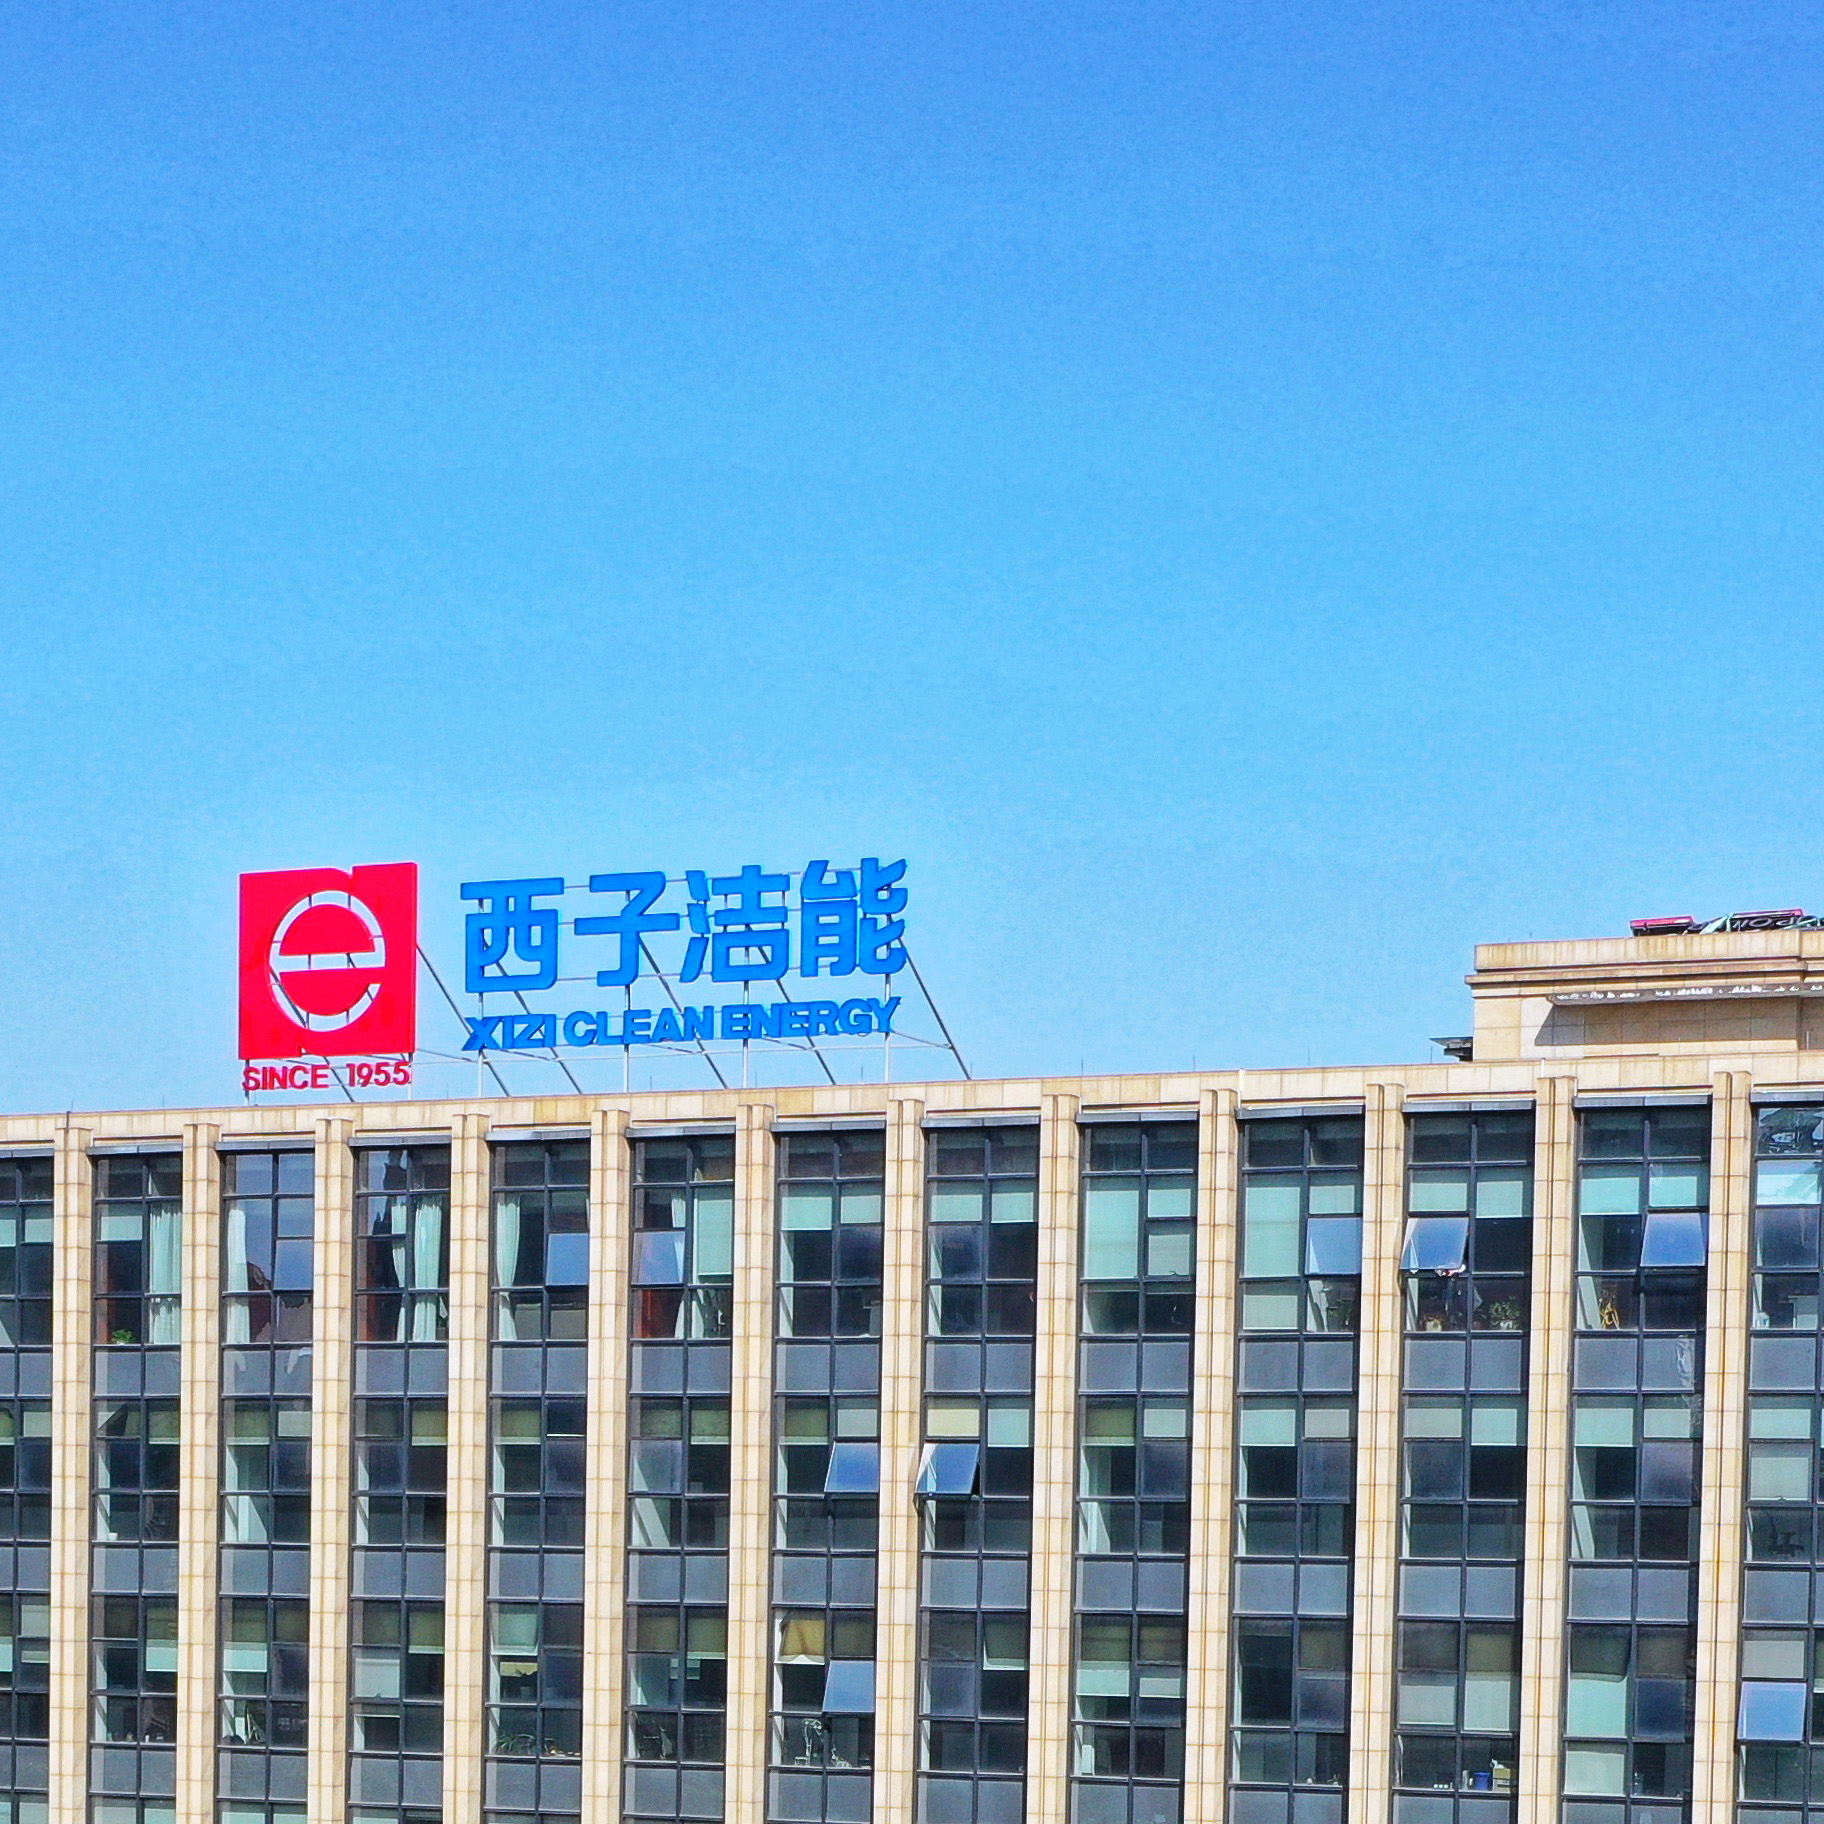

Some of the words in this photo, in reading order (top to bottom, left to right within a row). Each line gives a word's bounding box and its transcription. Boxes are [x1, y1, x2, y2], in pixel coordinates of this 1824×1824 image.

[461, 857, 908, 993] 西子洁能
[462, 1013, 556, 1051] XIZI
[563, 1005, 715, 1047] CLEAN
[721, 996, 902, 1040] ENERGY
[242, 1064, 330, 1091] SINCE
[345, 1060, 413, 1088] 1955
